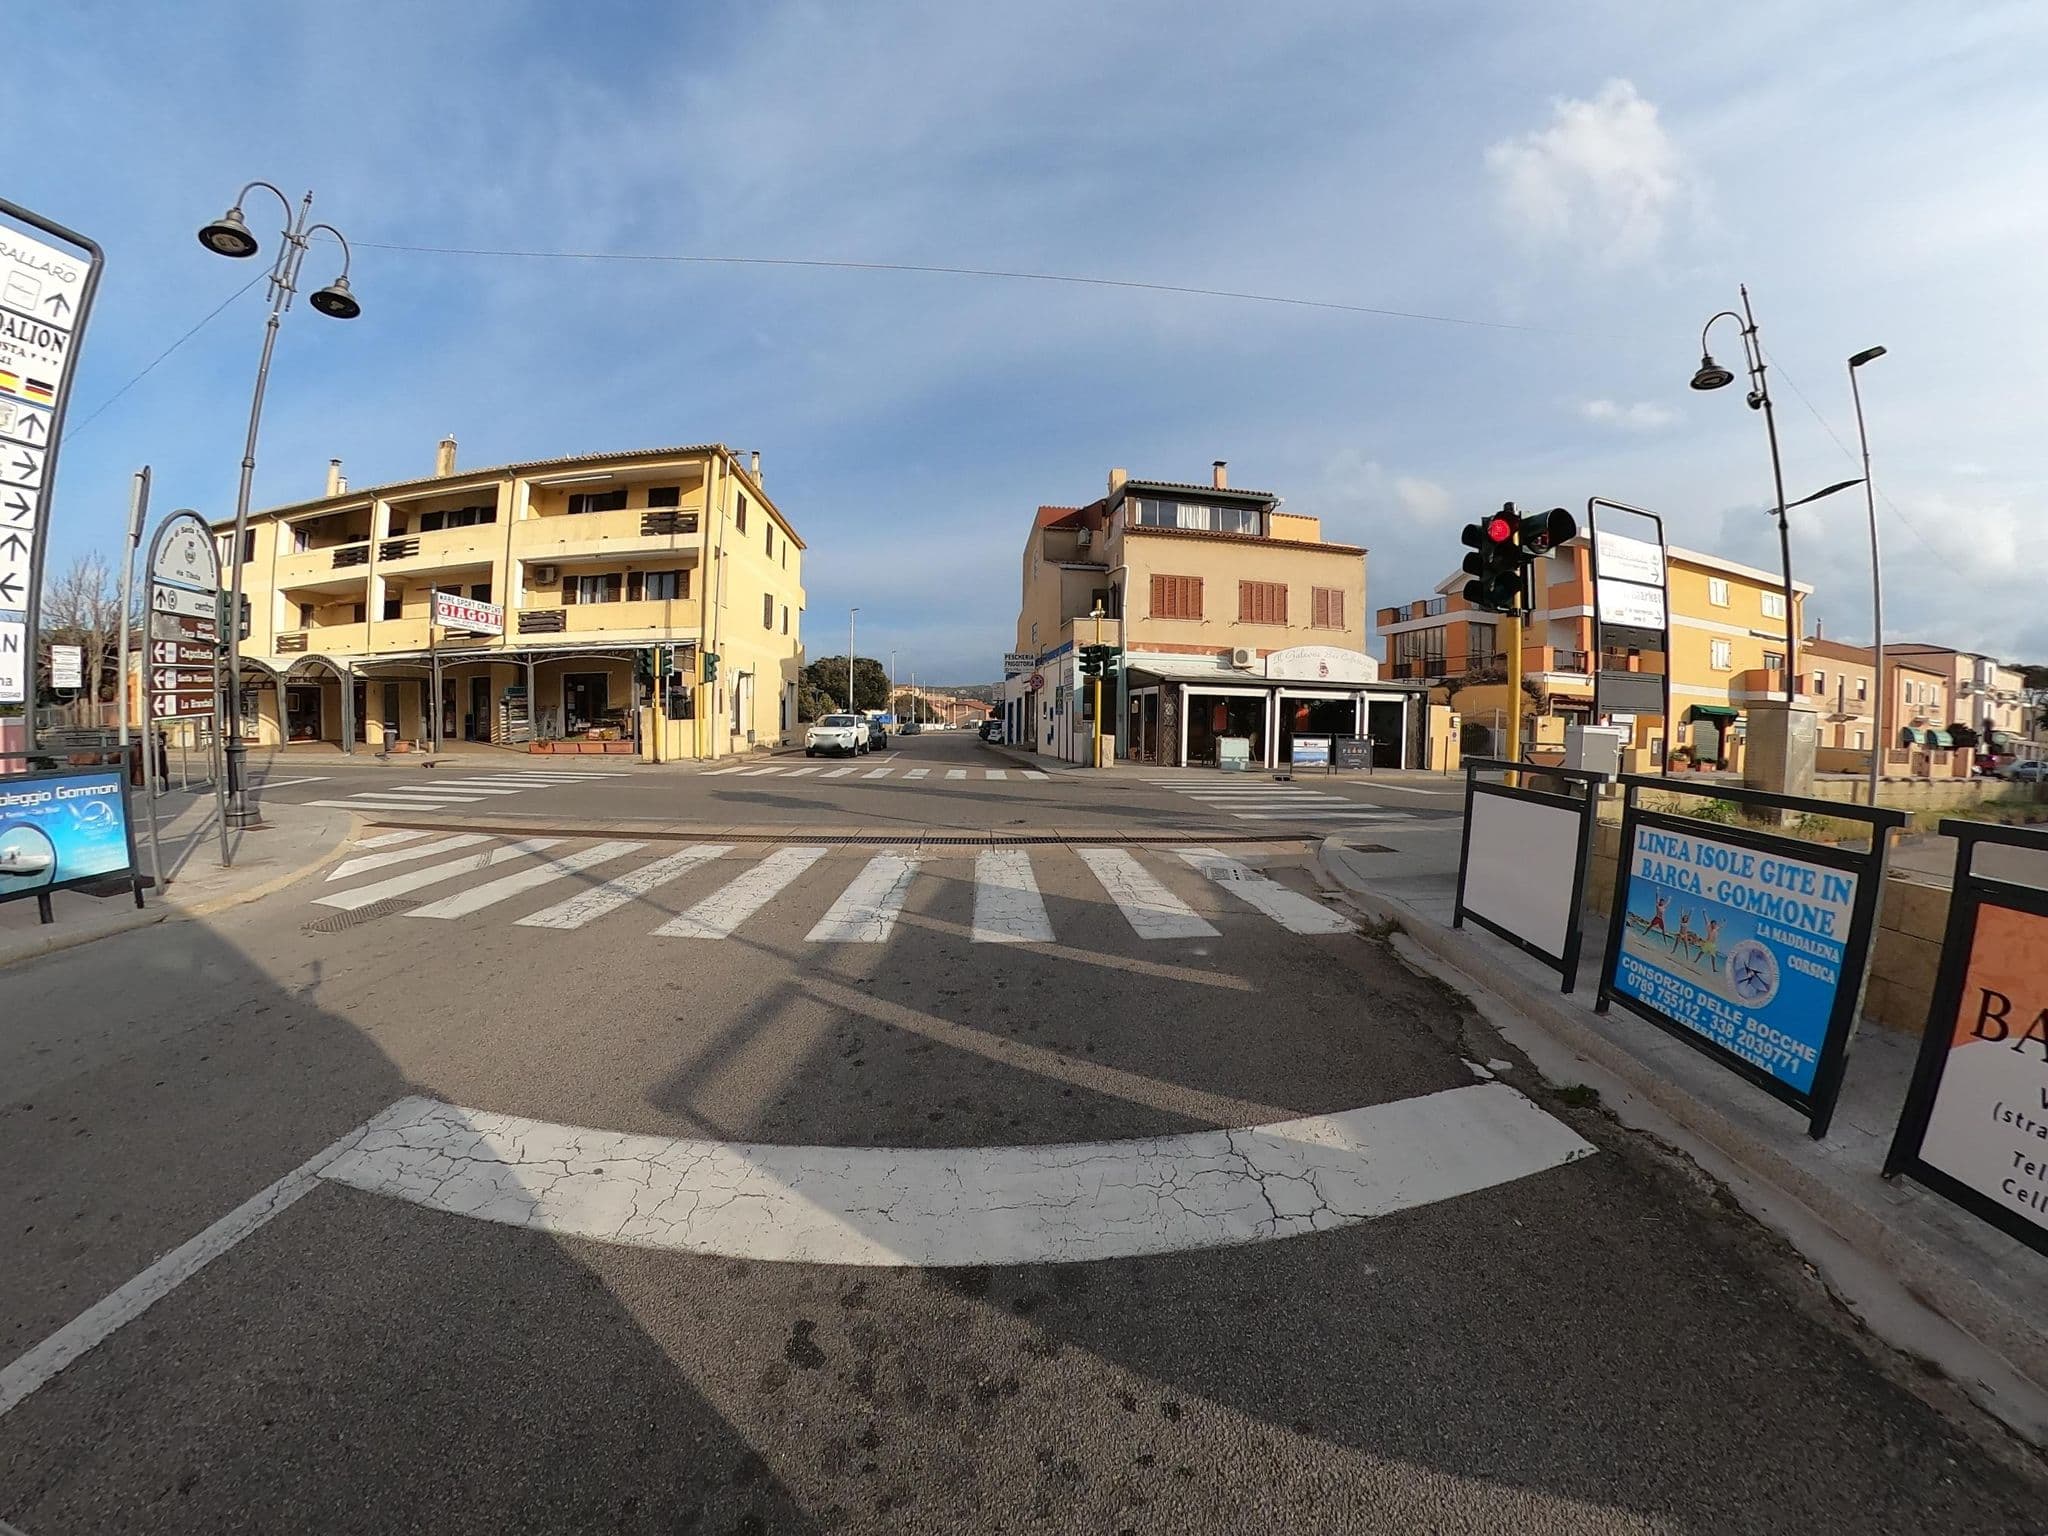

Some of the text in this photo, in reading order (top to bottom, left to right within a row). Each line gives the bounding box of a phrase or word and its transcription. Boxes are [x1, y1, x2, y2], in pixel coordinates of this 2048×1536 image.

[438, 603, 502, 626] GIAGONI
[56, 782, 118, 800] Gommoni
[1638, 831, 1853, 906] LINEA ISOLE GITE IN
[1642, 858, 1702, 894] BARCA
[1717, 880, 1836, 937] GOMMONE
[1757, 922, 1840, 963] LA MADDALENA
[1787, 954, 1836, 984] CORSICA
[1622, 956, 1694, 1000] CONSORZIO
[1699, 993, 1742, 1024] DELLE
[1746, 1018, 1817, 1064] BOCCHE
[1627, 972, 1654, 996] 0789
[1657, 985, 1699, 1019] 755112
[1709, 1015, 1735, 1039] 338
[1738, 1032, 1800, 1075] 2039771
[1638, 993, 1672, 1018] SANTA
[1674, 1010, 1715, 1042] TERESA
[1993, 1102, 2047, 1139] (stra
